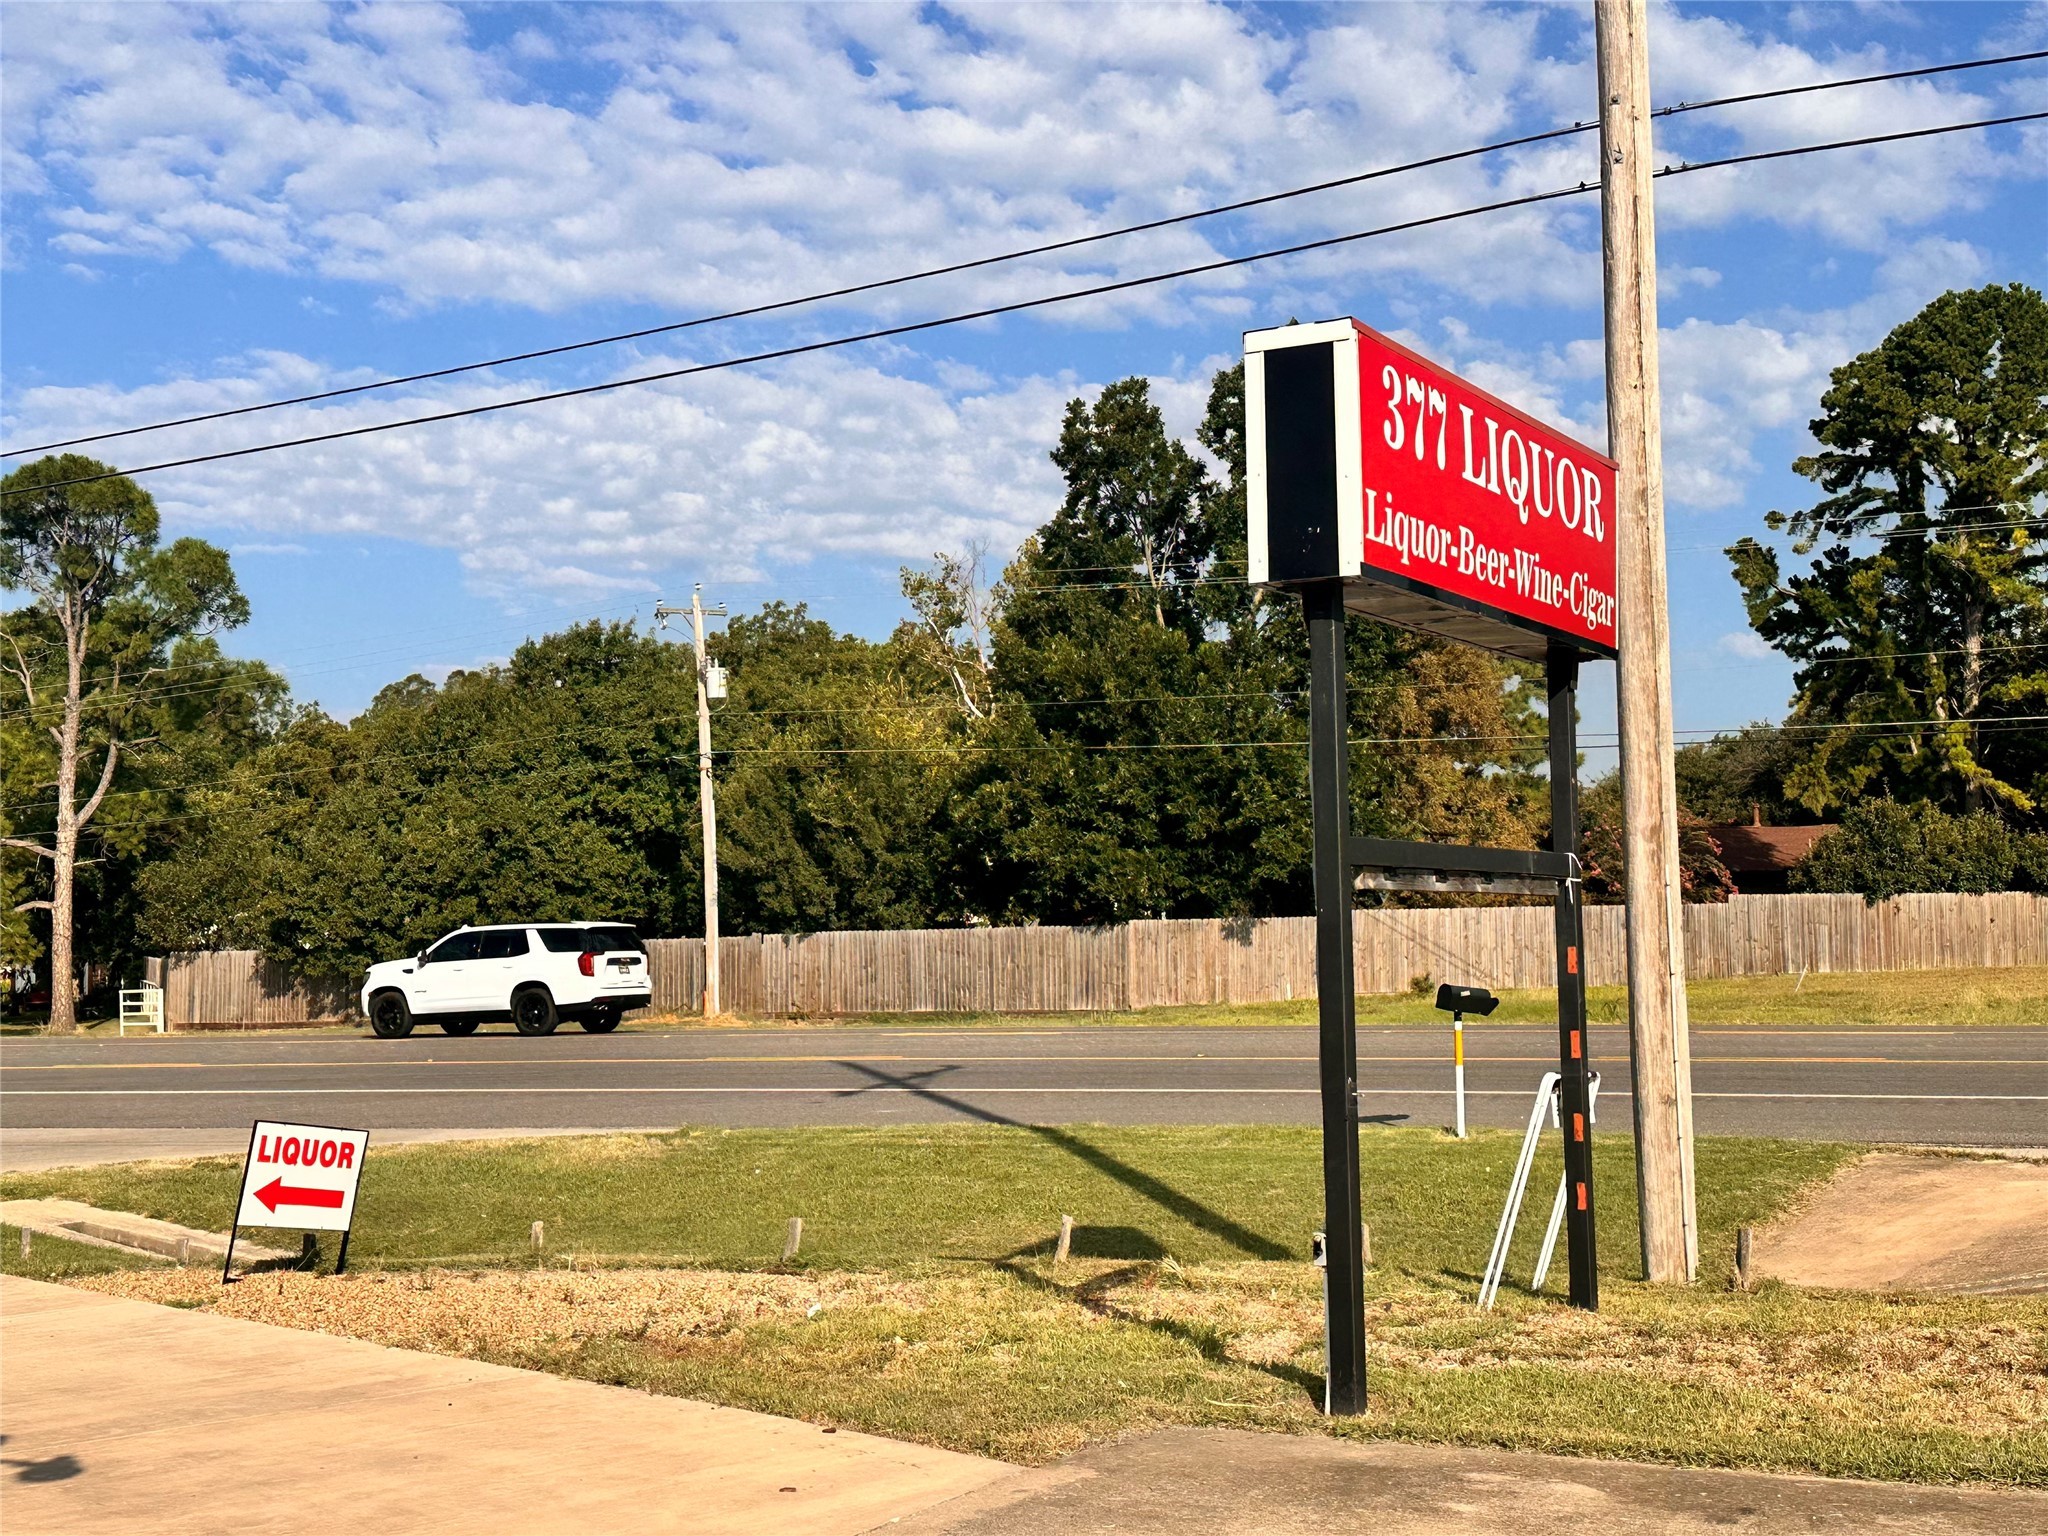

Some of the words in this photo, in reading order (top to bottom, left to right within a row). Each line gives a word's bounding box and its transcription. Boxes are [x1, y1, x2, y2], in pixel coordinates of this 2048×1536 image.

[1382, 364, 1447, 471] 377
[1458, 403, 1605, 543] LIQUOR
[1365, 487, 1614, 631] Liquor-Beer-Wine-Cigar
[257, 1135, 355, 1169] LIQUOR
